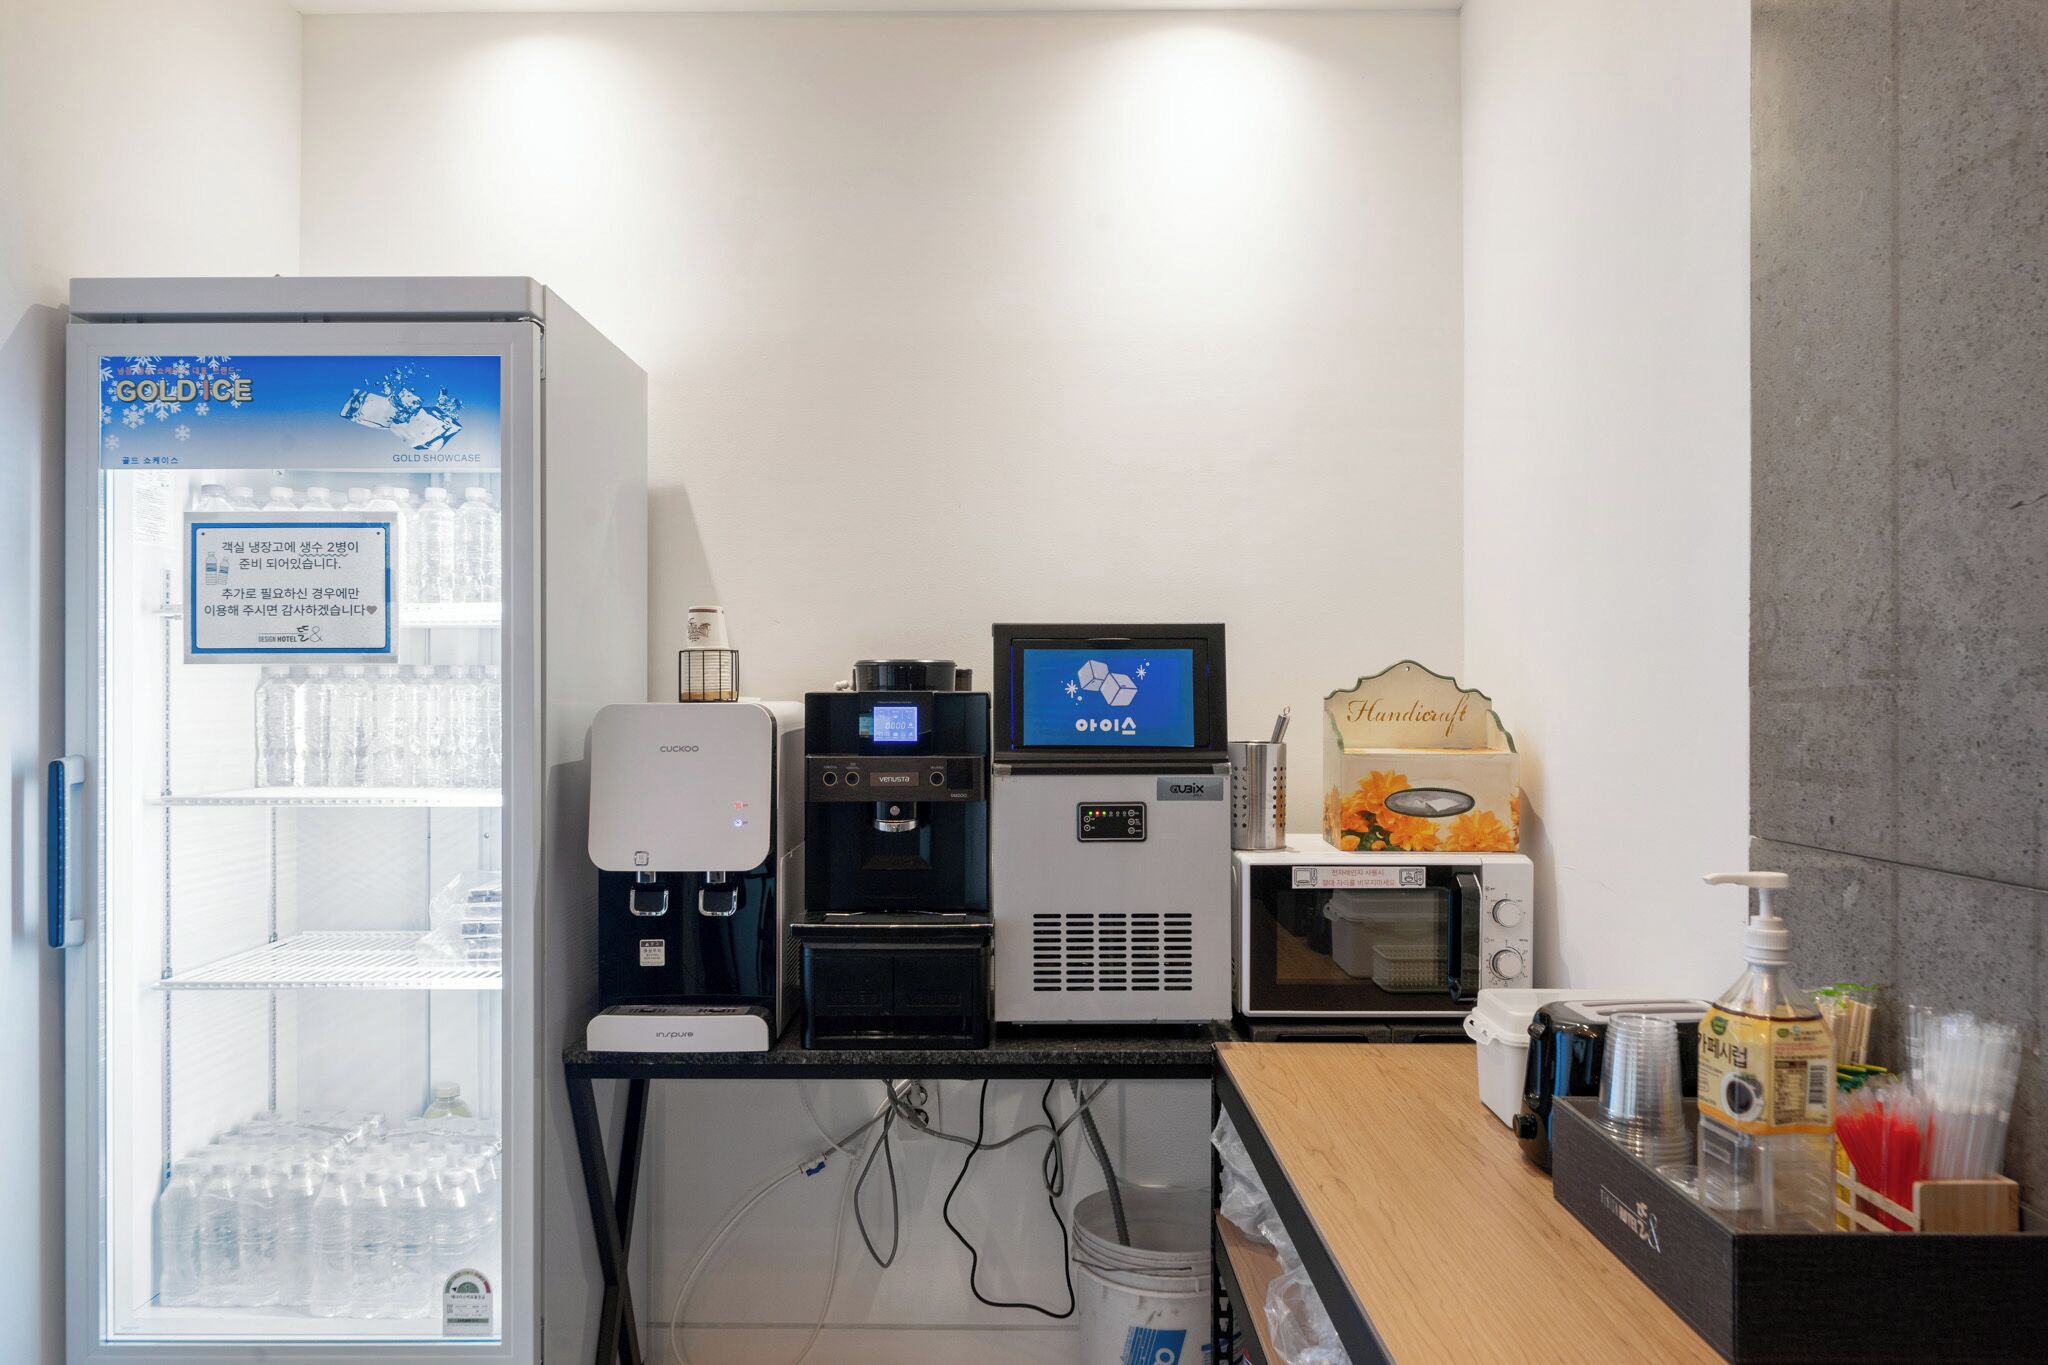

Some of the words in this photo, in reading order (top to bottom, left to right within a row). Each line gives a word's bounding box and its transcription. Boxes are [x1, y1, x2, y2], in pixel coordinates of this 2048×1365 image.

[115, 377, 198, 403] GOLD
[202, 377, 254, 403] ICE
[122, 456, 139, 465] 골드
[143, 456, 180, 465] 쇼케이스
[392, 454, 421, 463] GOLD
[423, 454, 481, 463] SHOWCASE
[221, 541, 245, 554] 객실
[248, 541, 296, 554] 냉장고에
[299, 541, 324, 554] 생수
[327, 541, 359, 554] 2병이
[239, 558, 262, 570] 준비
[266, 558, 341, 570] 되어있습니다.
[221, 587, 257, 600] 추가로
[260, 587, 308, 600] 필요하신
[311, 587, 360, 600] 경우에만
[204, 604, 239, 617] 이용해
[242, 604, 278, 617] 주시면
[277, 635, 298, 643] HOTEL
[1346, 693, 1470, 737] Handicraft
[1075, 716, 1137, 736] 아이스
[660, 745, 699, 753] CUCKOO
[656, 1031, 694, 1039] inspure
